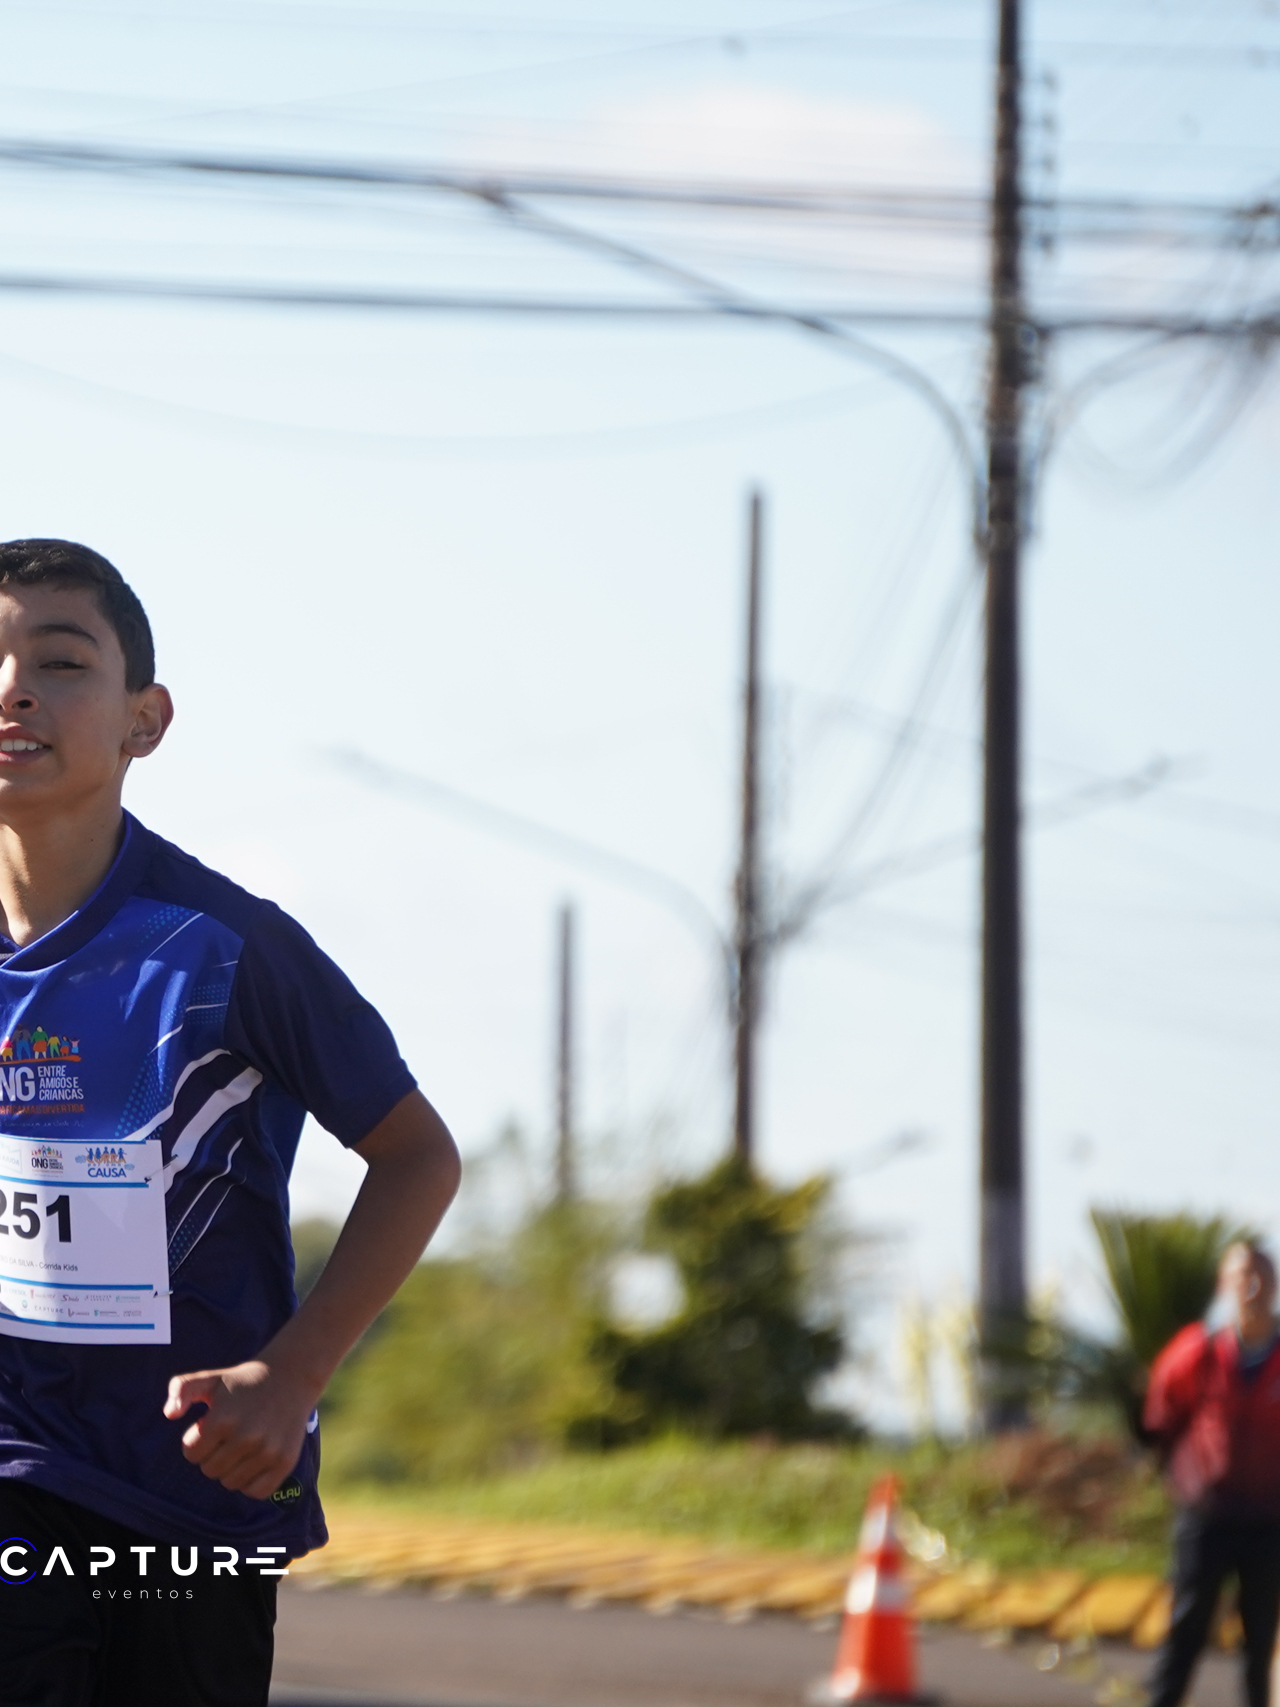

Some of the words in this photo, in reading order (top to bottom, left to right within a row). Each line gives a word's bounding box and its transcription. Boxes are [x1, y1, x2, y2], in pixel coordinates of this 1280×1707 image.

[37, 1065, 67, 1077] ENTRE
[39, 1077, 73, 1089] AMIGOS
[31, 1157, 49, 1170] ONG
[87, 1167, 128, 1178] CAUSA
[17, 1258, 35, 1268] SILVA
[39, 1262, 62, 1271] Corrida
[63, 1263, 79, 1272] Kids
